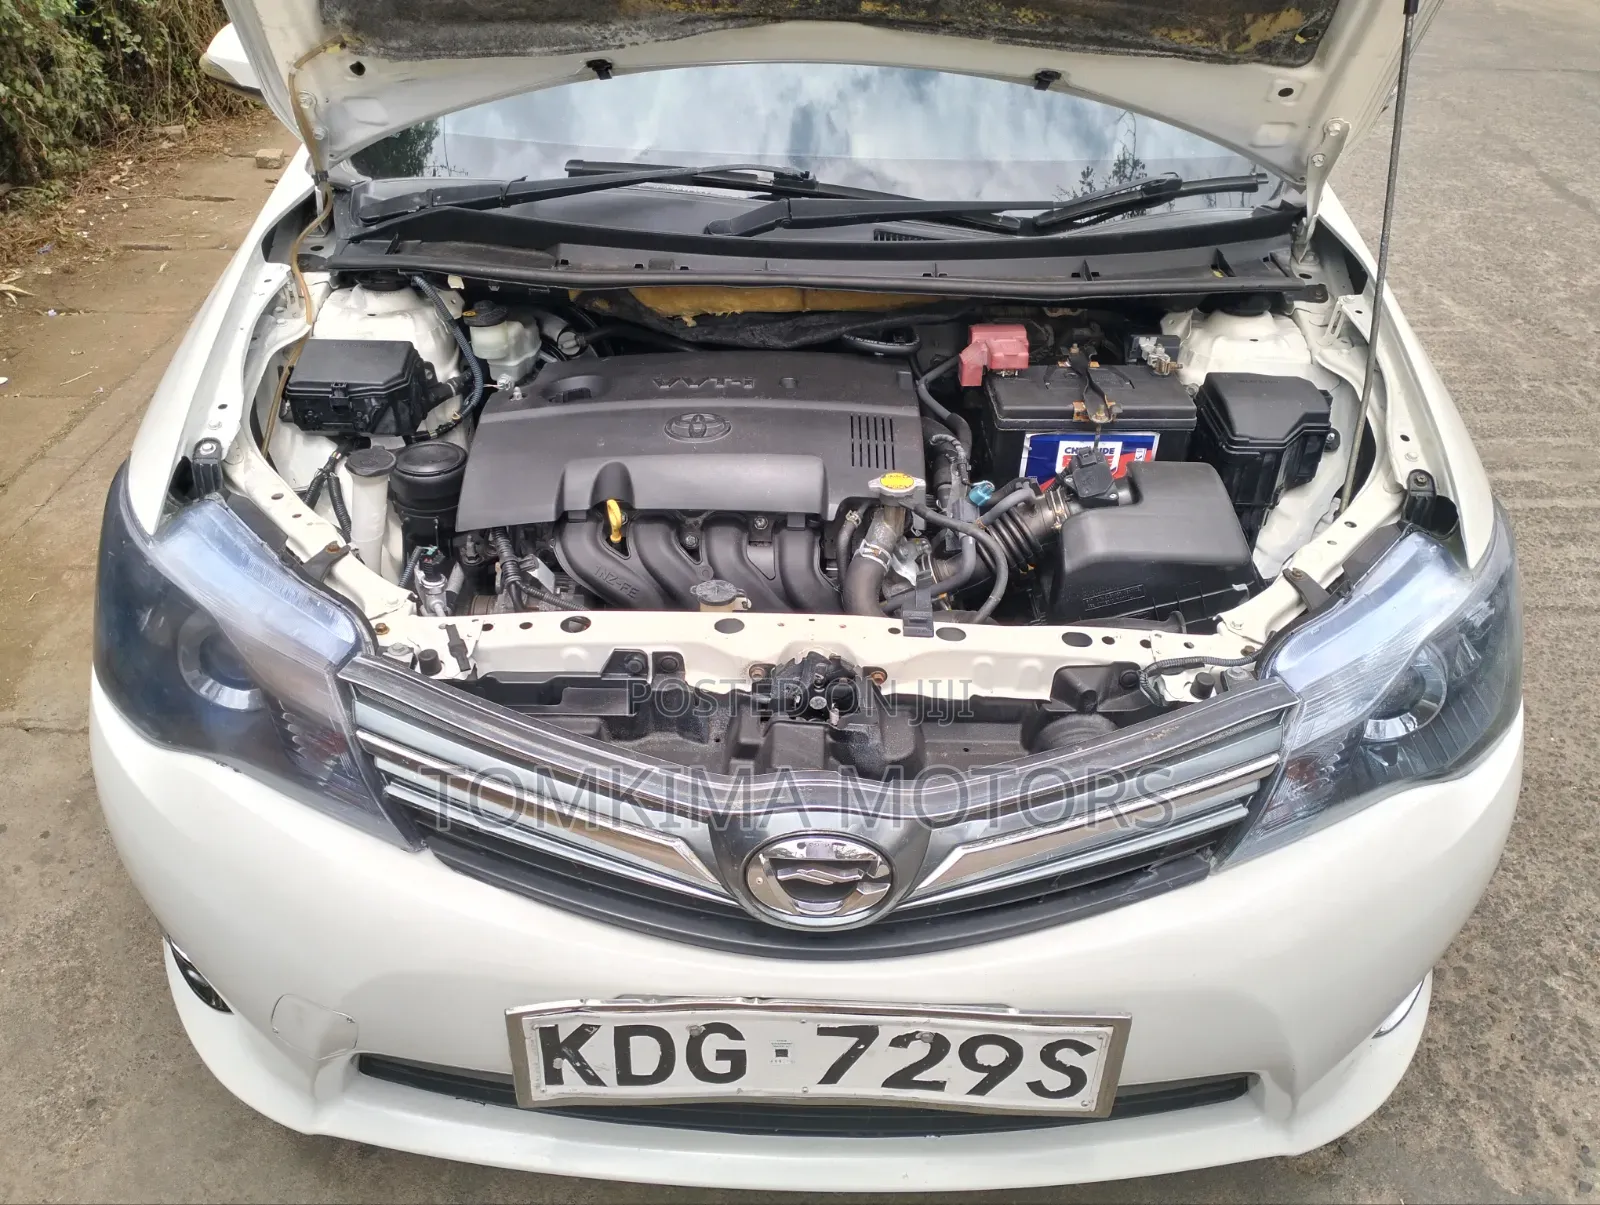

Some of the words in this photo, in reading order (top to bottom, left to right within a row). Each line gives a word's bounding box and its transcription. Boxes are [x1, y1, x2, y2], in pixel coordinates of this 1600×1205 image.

[1064, 446, 1116, 455] CHIDE
[594, 564, 640, 600] 1NZ-FE
[538, 1021, 748, 1088] KDG
[816, 1024, 1097, 1100] 729S
